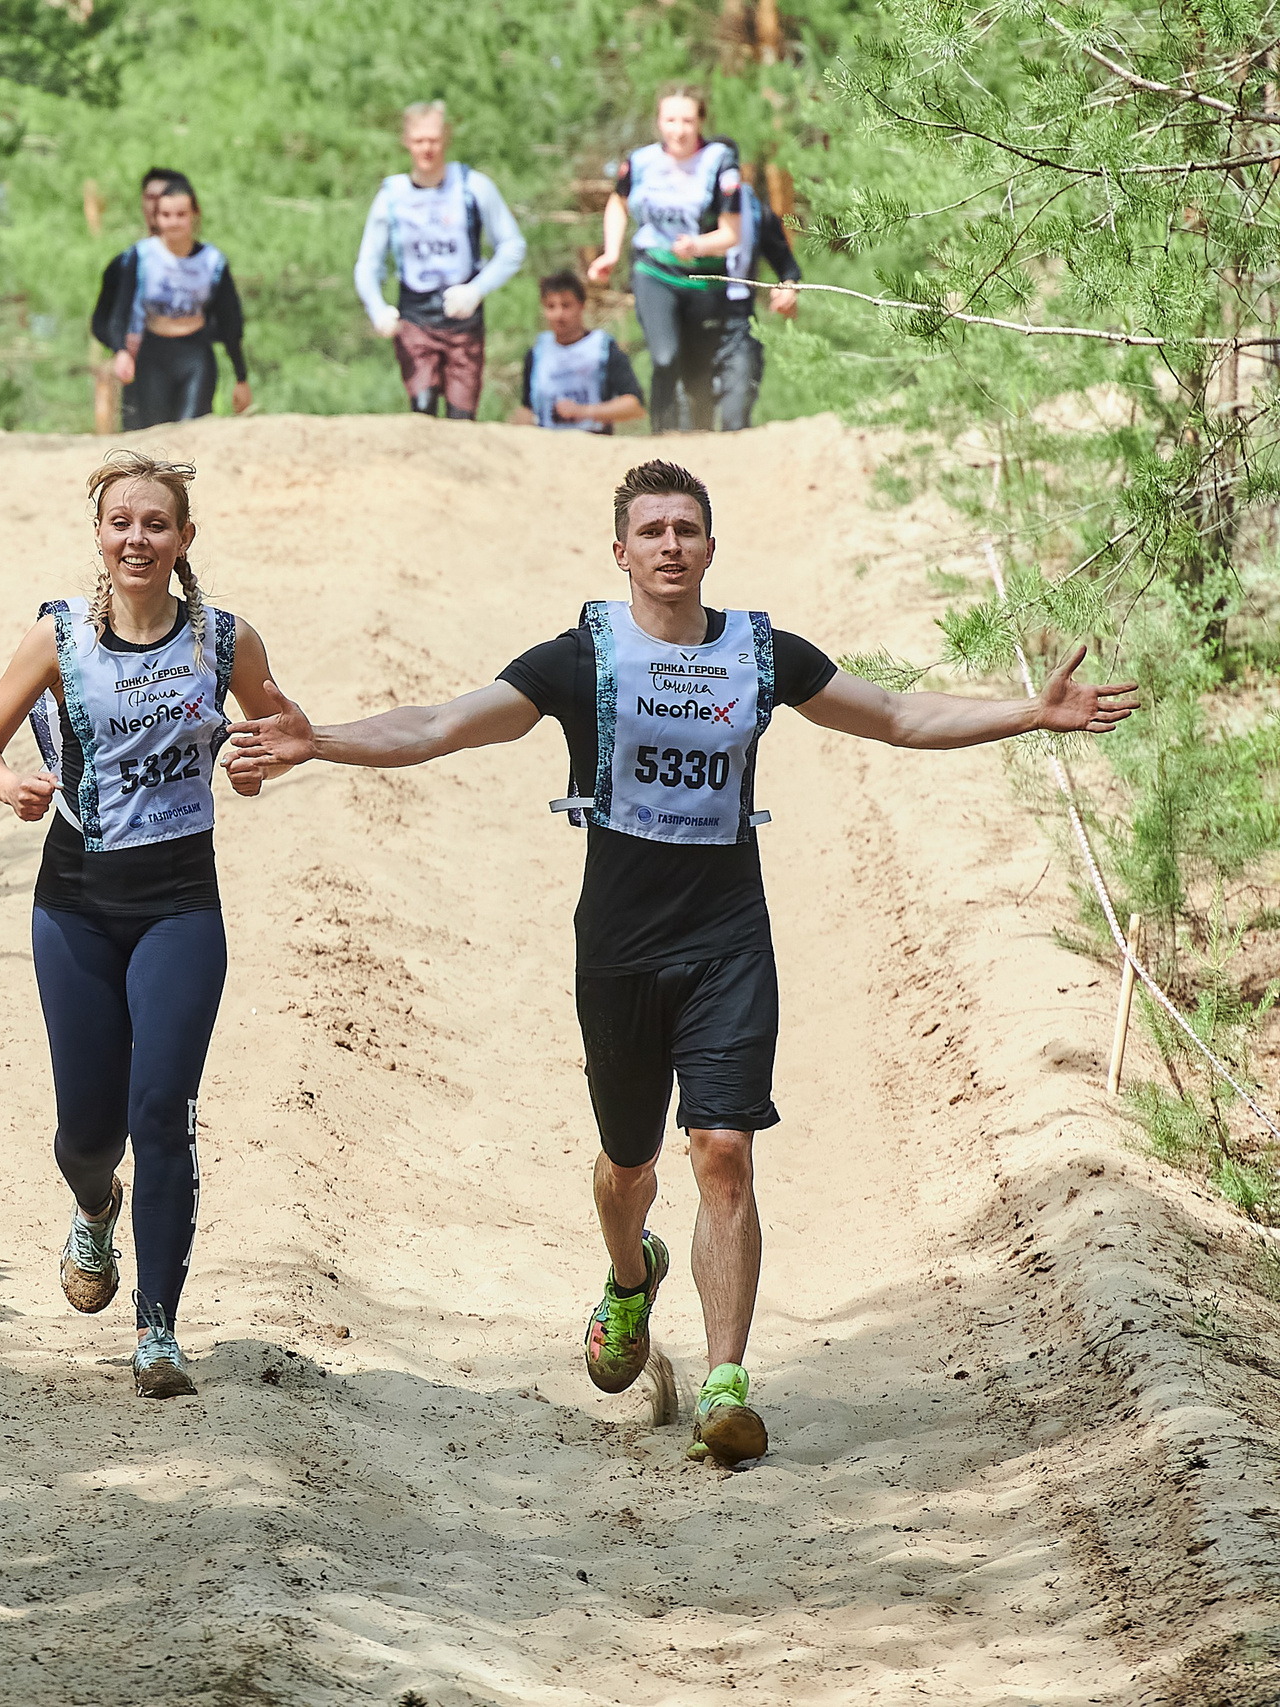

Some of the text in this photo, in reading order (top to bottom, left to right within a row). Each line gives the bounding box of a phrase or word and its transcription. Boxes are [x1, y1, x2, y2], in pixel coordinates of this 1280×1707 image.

[115, 665, 190, 689] ГОНКА ГЕРОЕВ
[650, 662, 727, 676] ГОНКА ГЕРОЕВ
[119, 744, 200, 795] 5322
[634, 745, 730, 791] 5330
[148, 802, 202, 824] ГАЗПРОМБАНК
[657, 813, 720, 827] ГАЗПРОМБАНК
